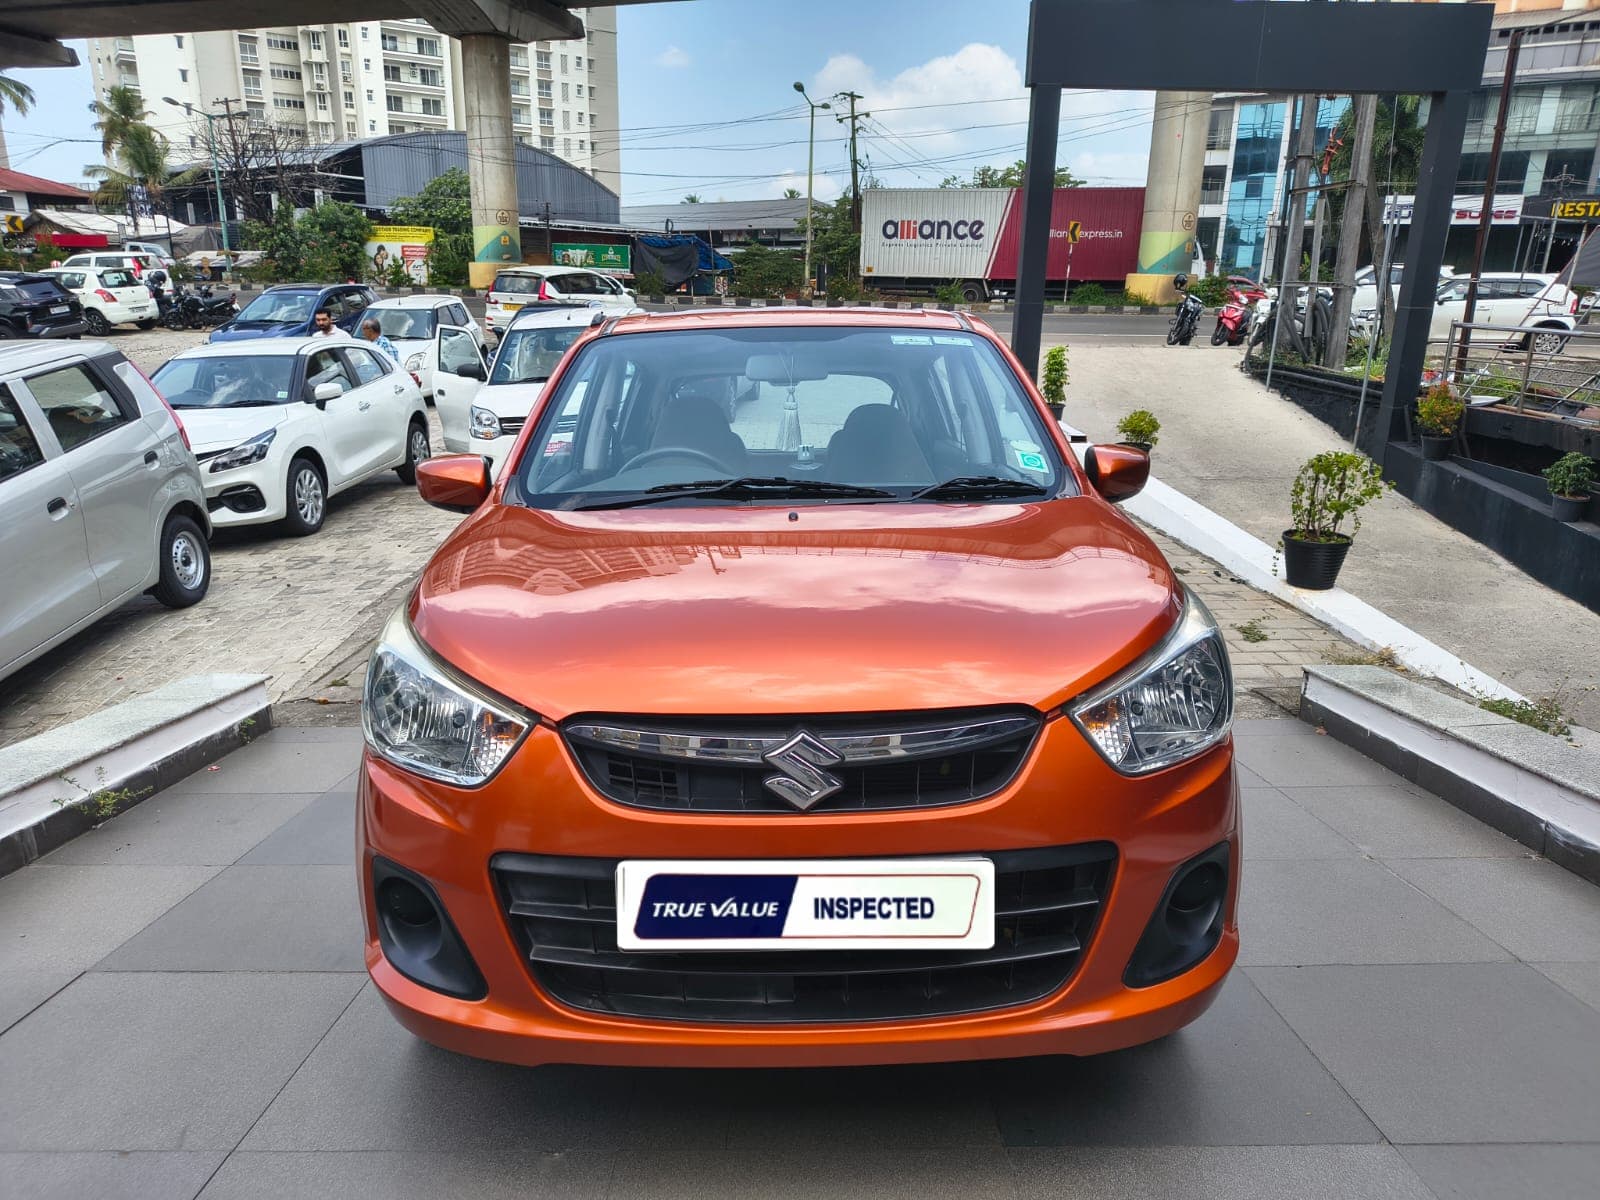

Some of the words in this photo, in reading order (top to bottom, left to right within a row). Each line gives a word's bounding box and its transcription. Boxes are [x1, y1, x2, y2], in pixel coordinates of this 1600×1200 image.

[1550, 201, 1600, 217] REST
[882, 219, 985, 240] alliance
[652, 901, 707, 918] TRUE
[710, 896, 780, 918] VALUE
[813, 896, 935, 920] INSPECTED
